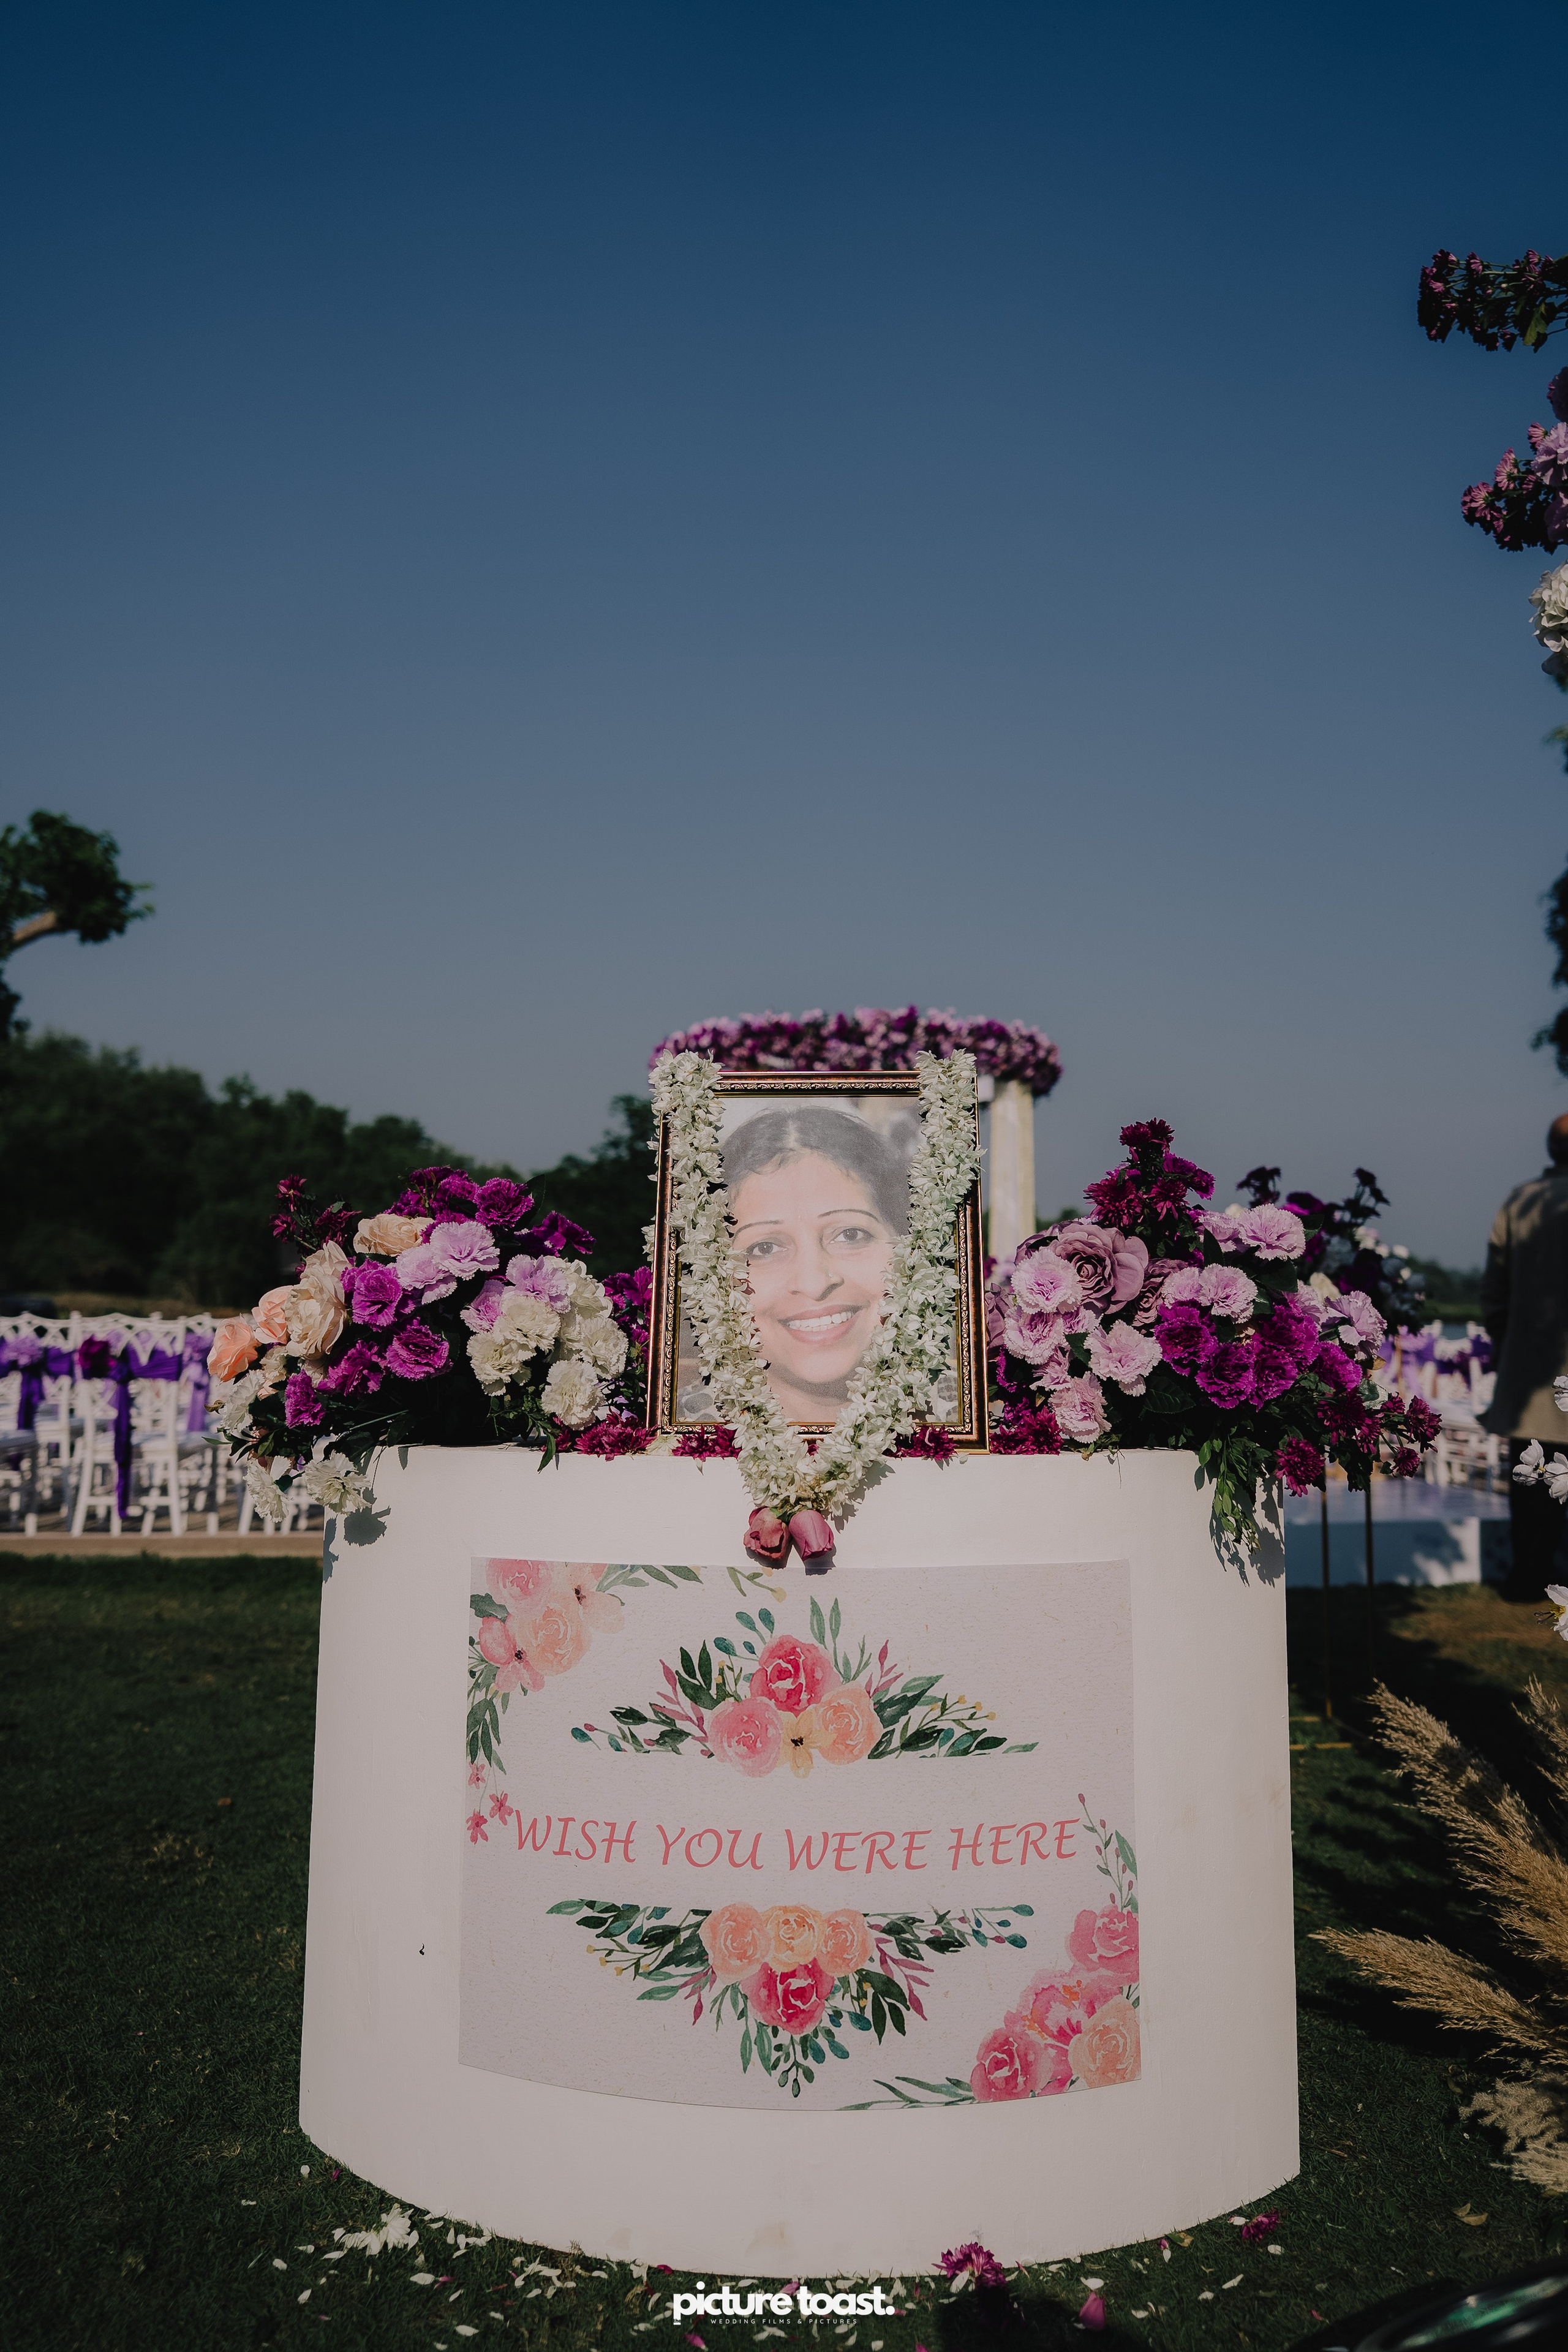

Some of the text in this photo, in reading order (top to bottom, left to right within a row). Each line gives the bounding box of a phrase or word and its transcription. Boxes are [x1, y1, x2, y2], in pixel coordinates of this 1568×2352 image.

[515, 1810, 1080, 1874] WISH YOU WERE HERE
